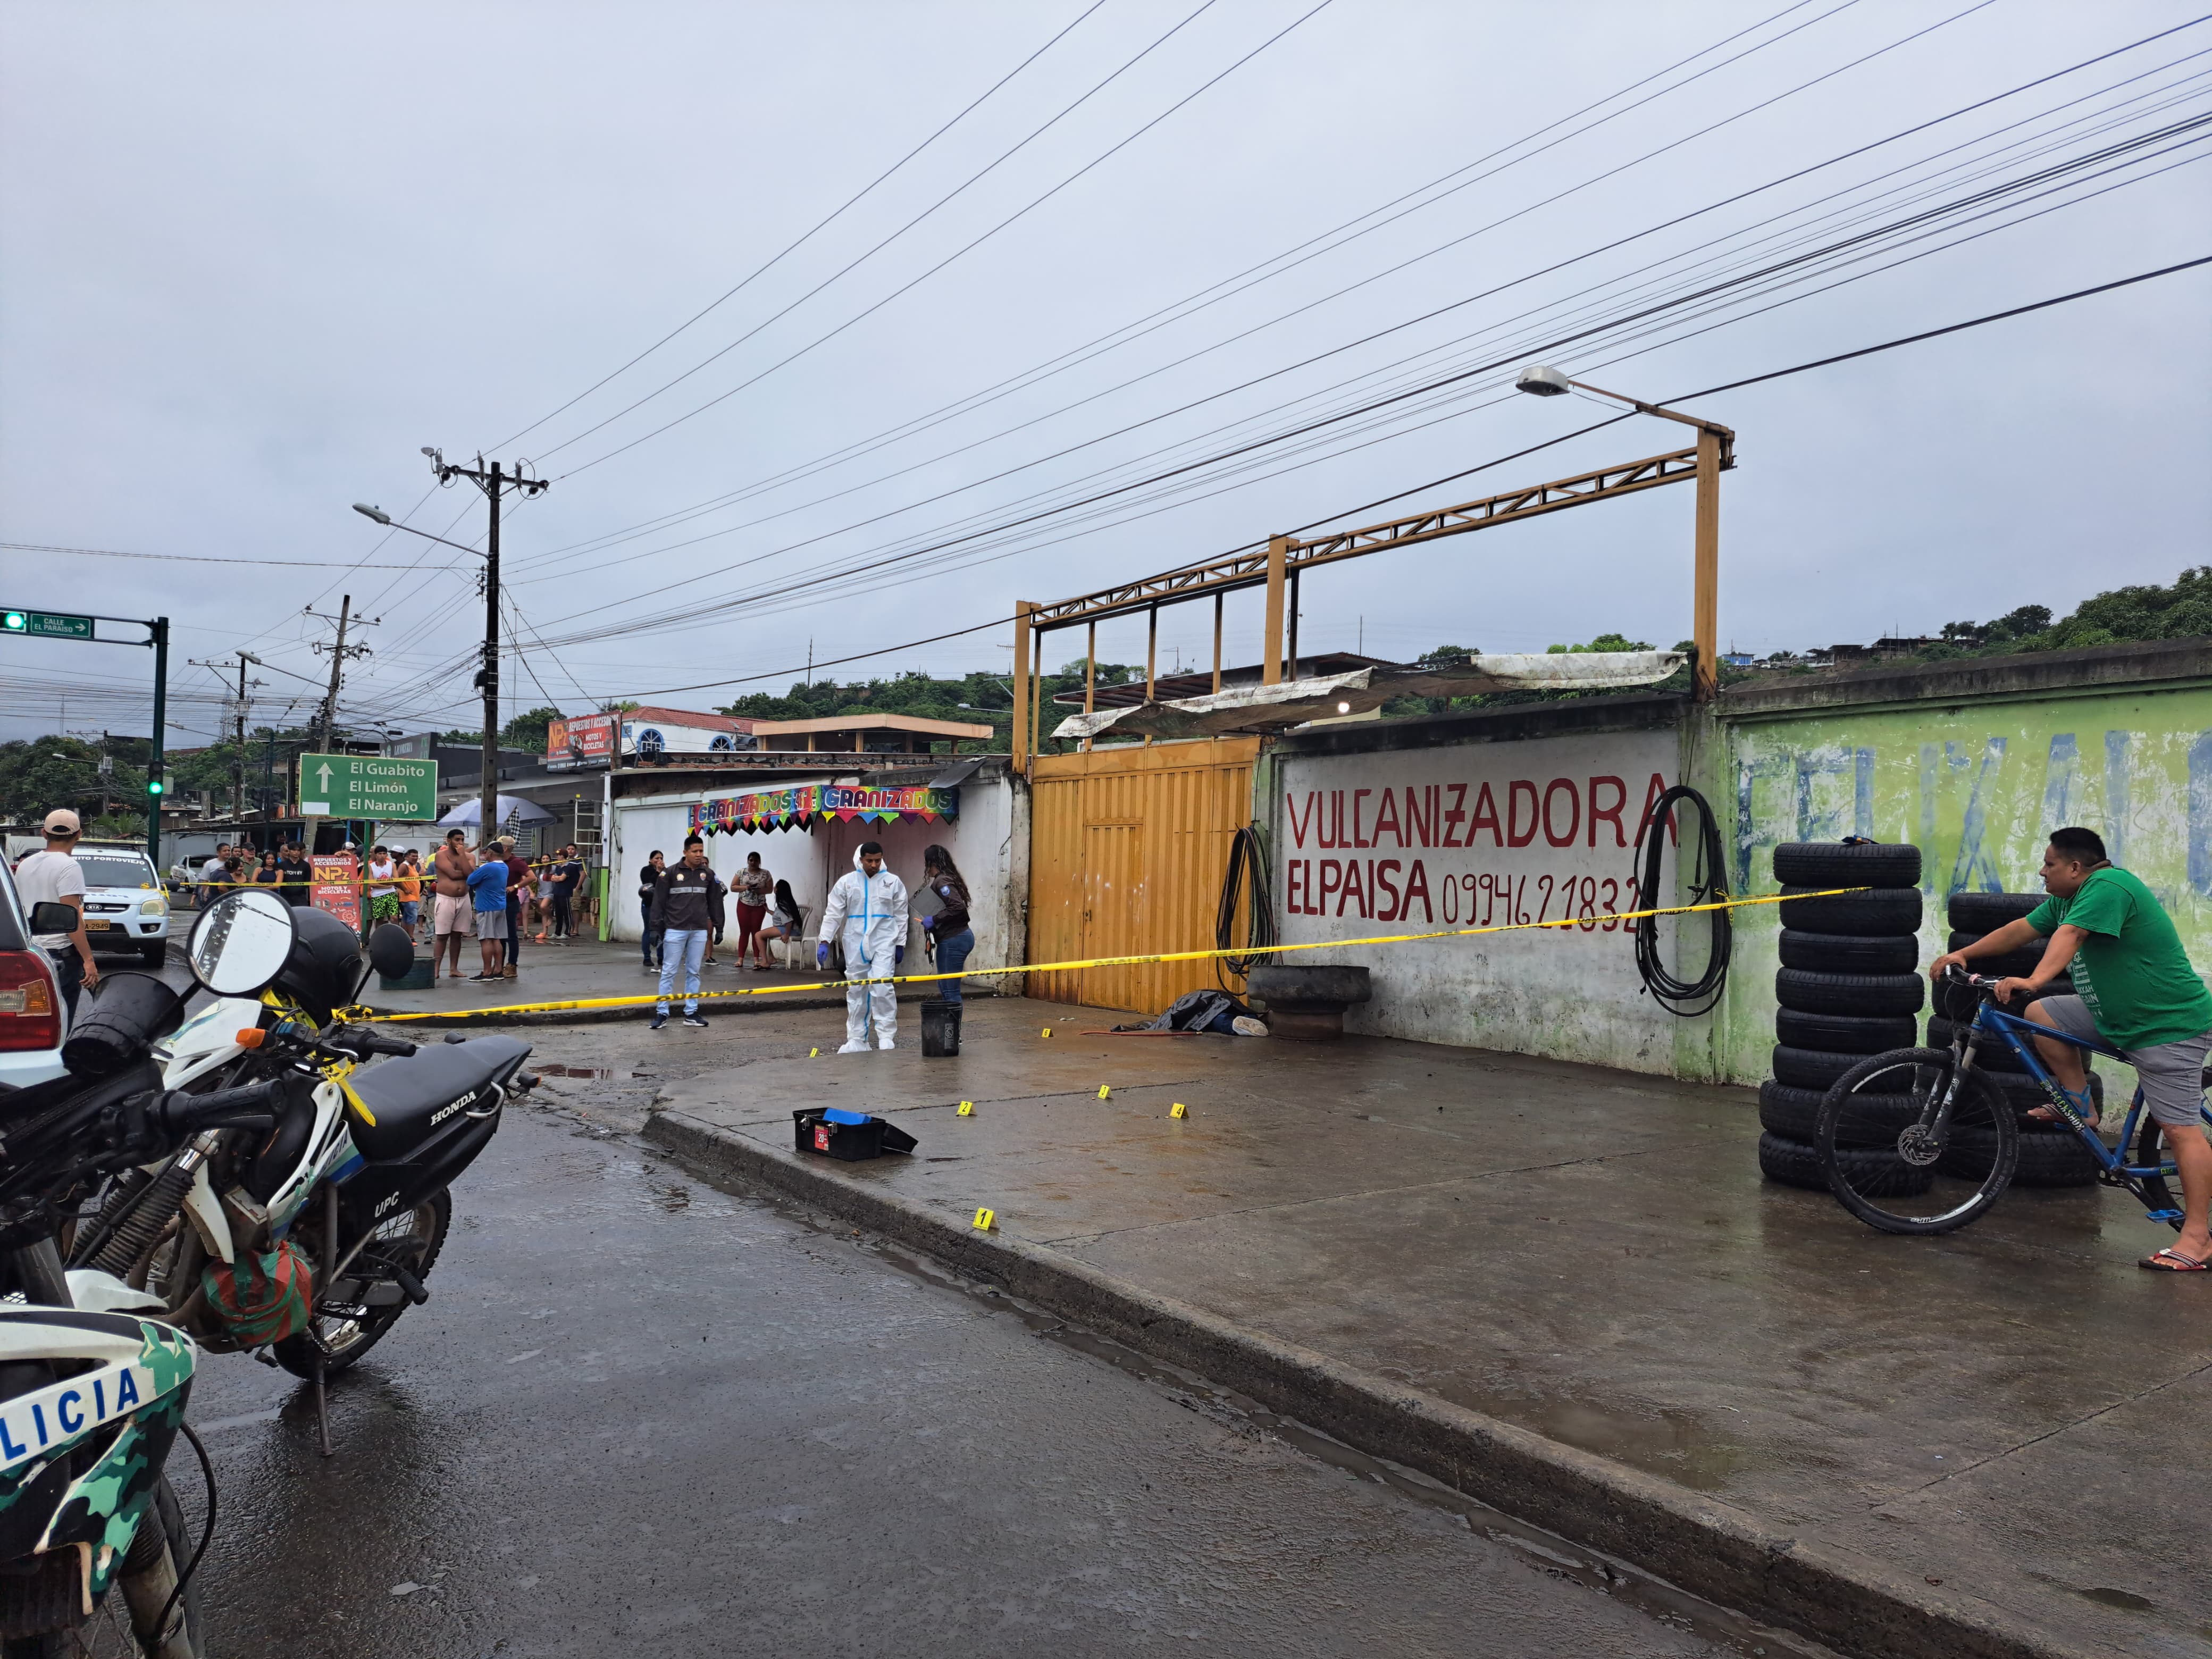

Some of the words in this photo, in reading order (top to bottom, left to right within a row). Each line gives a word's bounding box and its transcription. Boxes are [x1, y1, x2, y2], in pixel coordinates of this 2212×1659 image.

[350, 762, 363, 774] El
[366, 764, 425, 777] Guabito
[350, 781, 362, 792] El
[365, 781, 407, 793] Limón
[349, 799, 361, 810] El
[364, 799, 418, 815] Naranjo
[824, 789, 953, 809] GRANIZADOS
[698, 792, 791, 823] GRANIZADOS
[1287, 773, 1677, 849] VULCANIZADORA
[94, 857, 145, 865] PORTOVIEJO
[431, 1091, 476, 1126] HONDA
[962, 1102, 968, 1112] 2
[1176, 1107, 1182, 1116] 4
[374, 1191, 399, 1218] UPC
